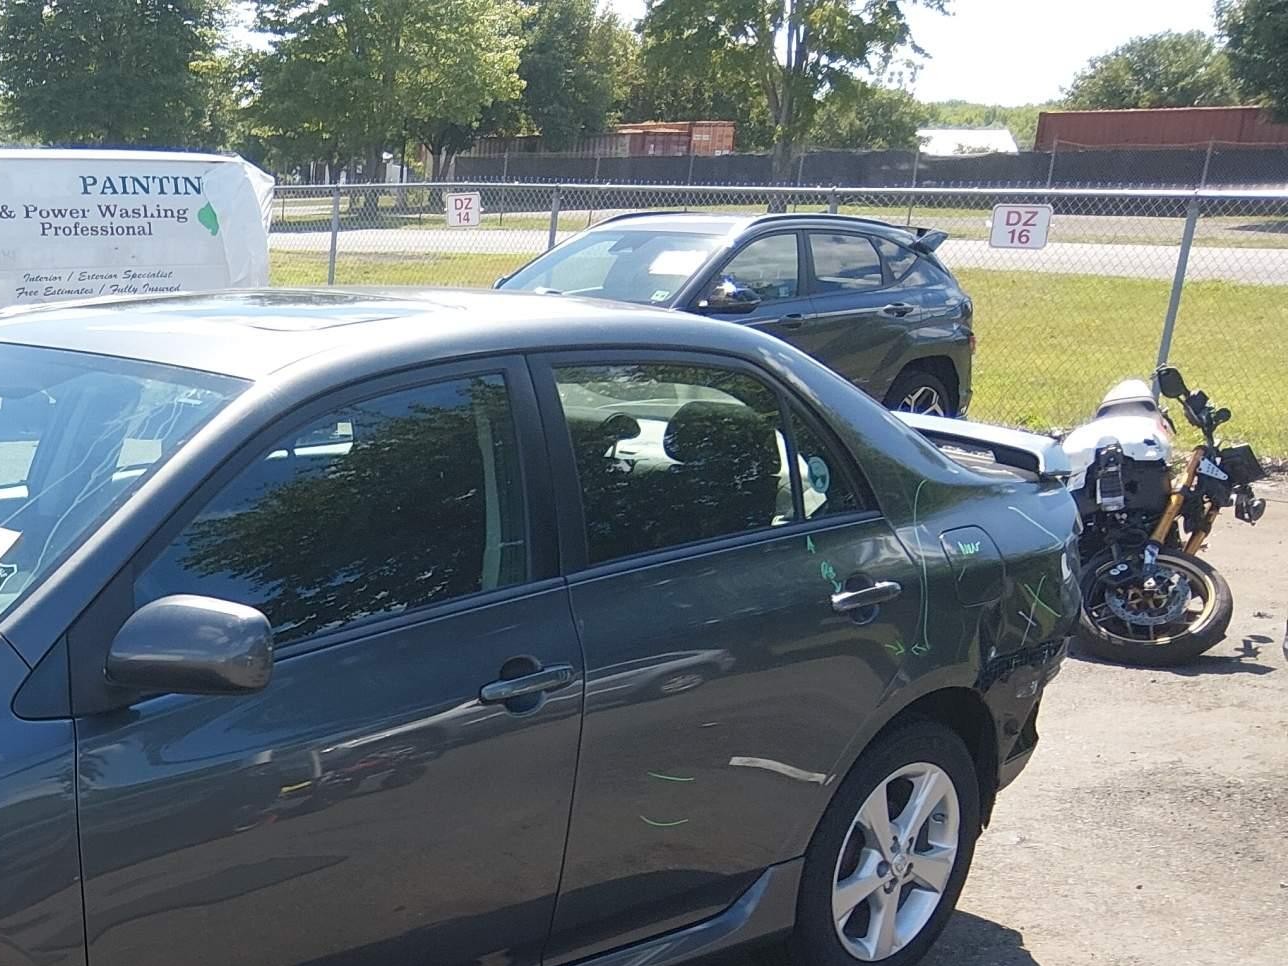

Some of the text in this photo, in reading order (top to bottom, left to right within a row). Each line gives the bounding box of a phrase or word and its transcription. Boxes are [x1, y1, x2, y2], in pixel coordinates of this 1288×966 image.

[79, 175, 203, 196] PAINTIN
[23, 204, 90, 219] Power
[454, 197, 473, 211] DZ
[456, 212, 470, 224] 14
[1006, 211, 1039, 226] DZ
[40, 221, 153, 237] Professional
[1008, 229, 1030, 244] 16
[23, 273, 62, 282] Interior
[122, 270, 173, 280] Specialist
[15, 286, 39, 298] Free
[43, 286, 93, 297] Estimates
